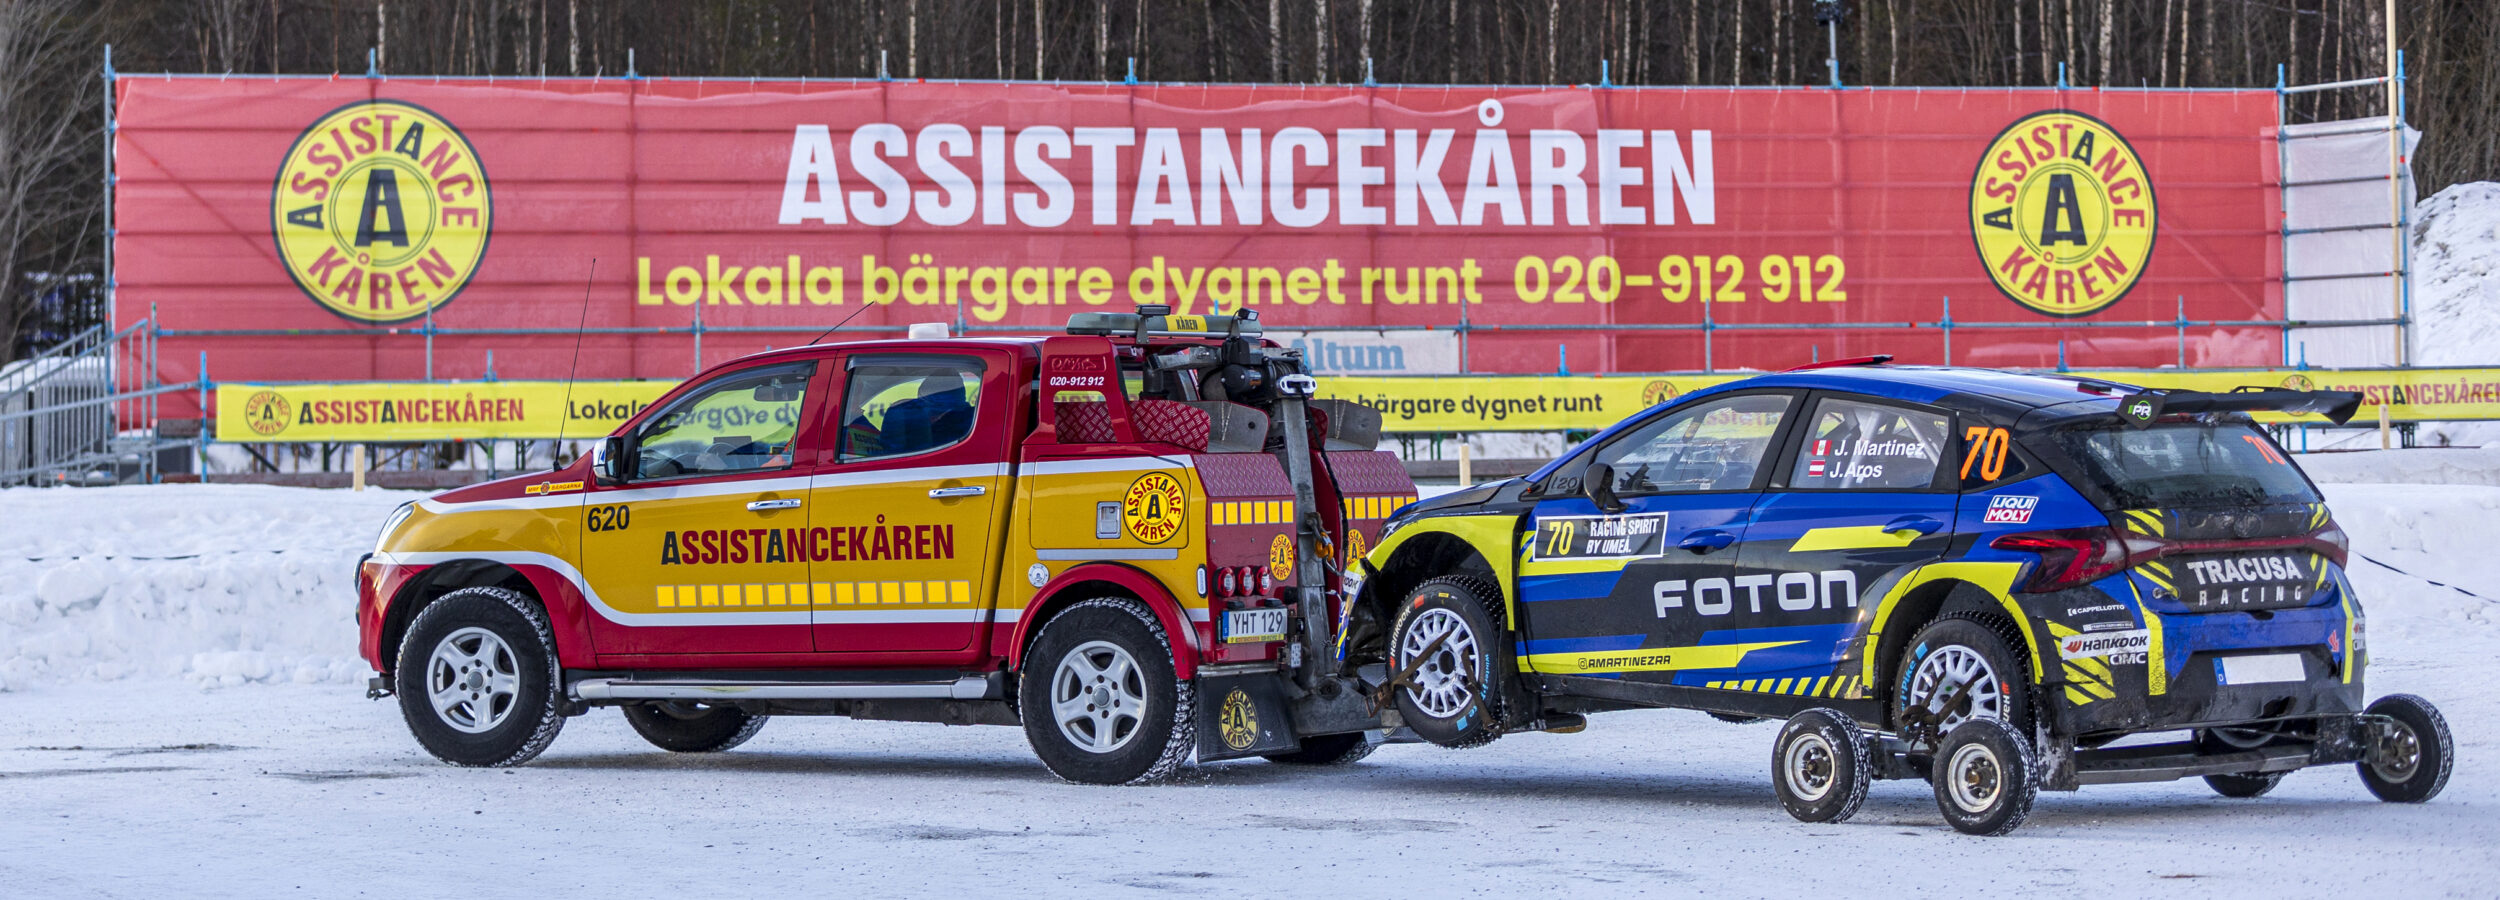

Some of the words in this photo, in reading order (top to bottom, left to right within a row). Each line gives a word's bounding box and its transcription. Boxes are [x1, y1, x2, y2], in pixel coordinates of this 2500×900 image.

[287, 114, 479, 231] ASSISTANCE
[778, 98, 1715, 228] ASSISTANCEKÅREN
[1982, 123, 2146, 231] ASSISTANCE
[354, 168, 410, 247] A
[2039, 173, 2088, 247] A
[307, 245, 456, 310] KÅREN
[637, 254, 844, 306] Lokala
[861, 252, 1114, 321] bärgare
[1127, 255, 1346, 319] dygnet
[1361, 258, 1483, 304] runt
[1513, 254, 1745, 304] 020-912
[1759, 254, 1848, 303] 912
[1999, 245, 2128, 304] KÅREN
[1050, 376, 1087, 386] 020-912
[1087, 376, 1105, 386] 912
[298, 392, 526, 425] ASSISTANCEKÅREN
[1461, 394, 1547, 421] dygnet
[1552, 393, 1603, 412] runt
[1853, 439, 1926, 457] Martinez
[1960, 426, 2010, 482] 70
[1127, 476, 1182, 517] ASSISTANCE
[1992, 495, 2040, 510] LIQUI
[588, 504, 630, 533] 620
[1590, 519, 1627, 538] RACING
[1627, 518, 1659, 535] SPIRIT
[1984, 509, 2033, 523] MOLY
[661, 514, 955, 565] ASSISTANCEKÅREN
[1546, 520, 1575, 556] 70
[1586, 539, 1600, 555] BY
[2187, 556, 2304, 585] TRACUSA
[1653, 569, 1858, 619] FOTON
[2199, 585, 2302, 606] RACING
[1233, 612, 1257, 635] YHT
[1261, 611, 1283, 633] 129
